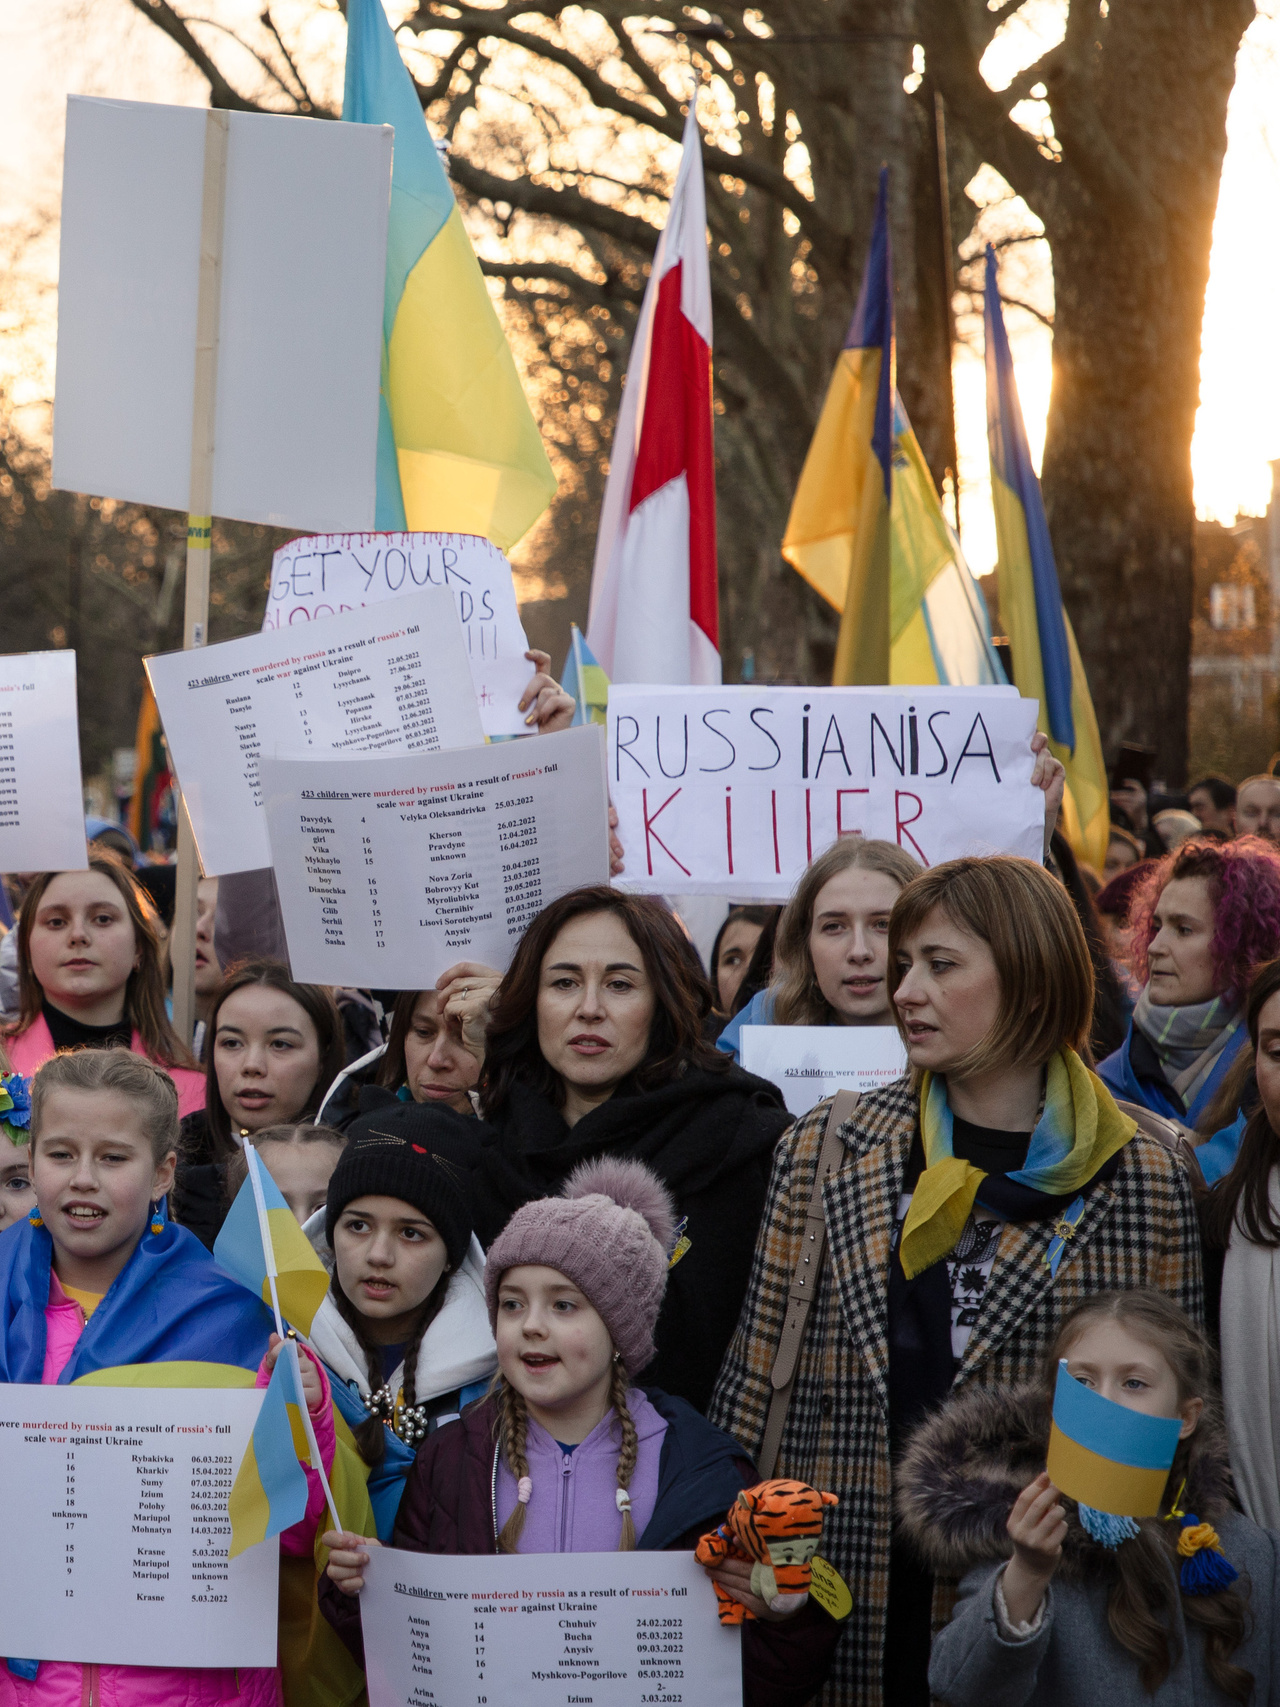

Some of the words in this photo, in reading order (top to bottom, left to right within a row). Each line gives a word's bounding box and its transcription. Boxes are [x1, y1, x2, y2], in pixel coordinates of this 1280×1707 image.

[272, 551, 342, 600] GET
[352, 548, 471, 591] YOUR
[387, 651, 419, 665] 22.05.2022
[252, 658, 290, 674] murdered
[294, 662, 320, 676] against
[322, 655, 353, 667] Ukraine
[338, 693, 375, 708] Lysychansk
[374, 786, 415, 797] murdered
[512, 768, 542, 780] russia's
[450, 791, 484, 801] Ukraine
[400, 813, 427, 822] Velyka
[495, 796, 533, 809] 25.03.2022
[429, 831, 462, 839] Kherson
[429, 841, 465, 851] Pravdyne
[305, 856, 340, 865] Mykhaylo
[435, 904, 474, 915] Chernihiv
[23, 1421, 68, 1430] murdered
[71, 1421, 82, 1432] by
[86, 1423, 112, 1431] russia
[136, 1424, 162, 1433] result
[165, 1424, 175, 1433] of
[177, 1425, 212, 1433] russia's
[215, 1425, 231, 1433] full
[24, 1434, 46, 1443] scale
[70, 1436, 102, 1446] against
[106, 1437, 143, 1446] Ukraine
[132, 1455, 174, 1464] Rybakivka
[136, 1466, 168, 1475] Kharkiv
[141, 1479, 163, 1488] Sumy
[191, 1479, 232, 1487] 07.03.2022
[141, 1490, 163, 1498] Izium
[139, 1502, 165, 1511] Polohy
[134, 1514, 170, 1523] Mariupol
[132, 1526, 172, 1535] Mohnatyn
[192, 1549, 228, 1557] 5.03.2022
[472, 1590, 519, 1599] murdered
[537, 1589, 565, 1598] russia
[589, 1588, 616, 1597] result
[632, 1588, 668, 1596] russia's
[671, 1587, 687, 1596] full
[474, 1604, 497, 1613] scale
[521, 1603, 555, 1613] against
[558, 1602, 597, 1611] Ukraine
[408, 1615, 430, 1626] Anton
[558, 1619, 597, 1628] Chuhuiv
[637, 1618, 682, 1627] 24.02.2022
[564, 1633, 592, 1641] Bucha
[637, 1631, 682, 1640] 05.03.2022
[564, 1645, 593, 1655] Anysiv
[637, 1644, 683, 1653] 09.03.2022
[532, 1670, 627, 1681] Myshkovo-Pogorilove
[568, 1695, 593, 1703] Izium
